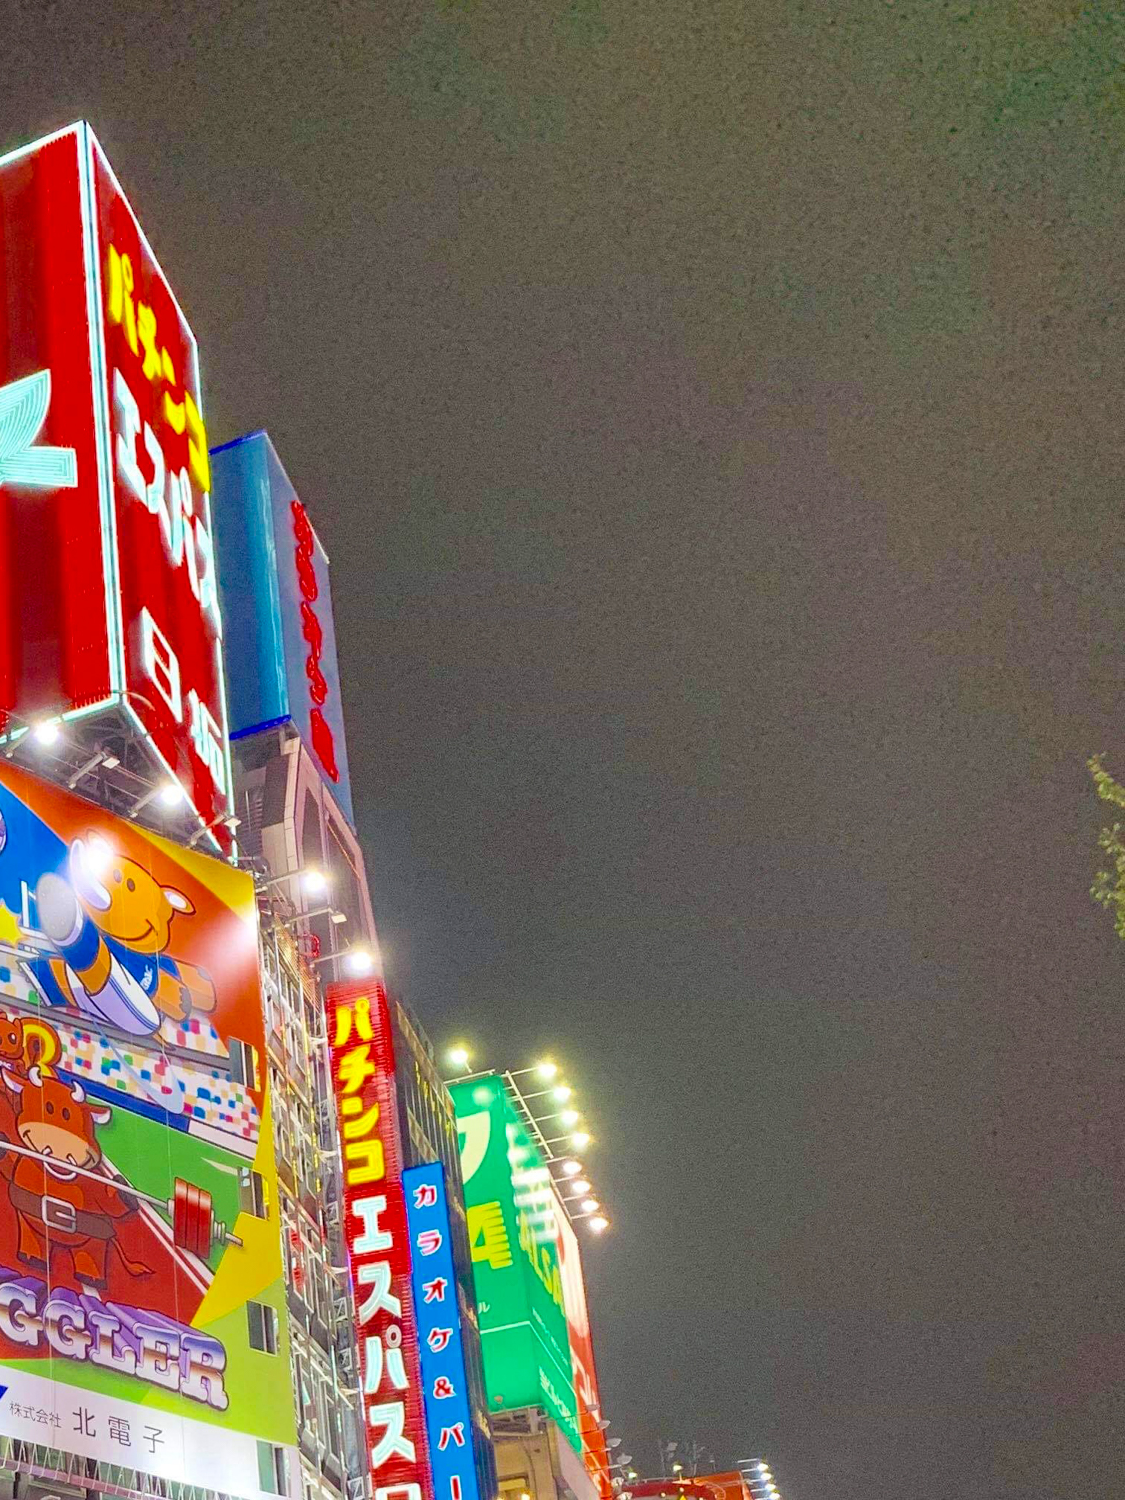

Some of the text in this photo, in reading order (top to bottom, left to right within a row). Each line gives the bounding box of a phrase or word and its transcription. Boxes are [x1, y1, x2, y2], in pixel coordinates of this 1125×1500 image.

[334, 998, 386, 1186] パチンコ
[351, 1194, 416, 1469] エスパス
[8, 1401, 165, 1454] 株式会社 北電子
